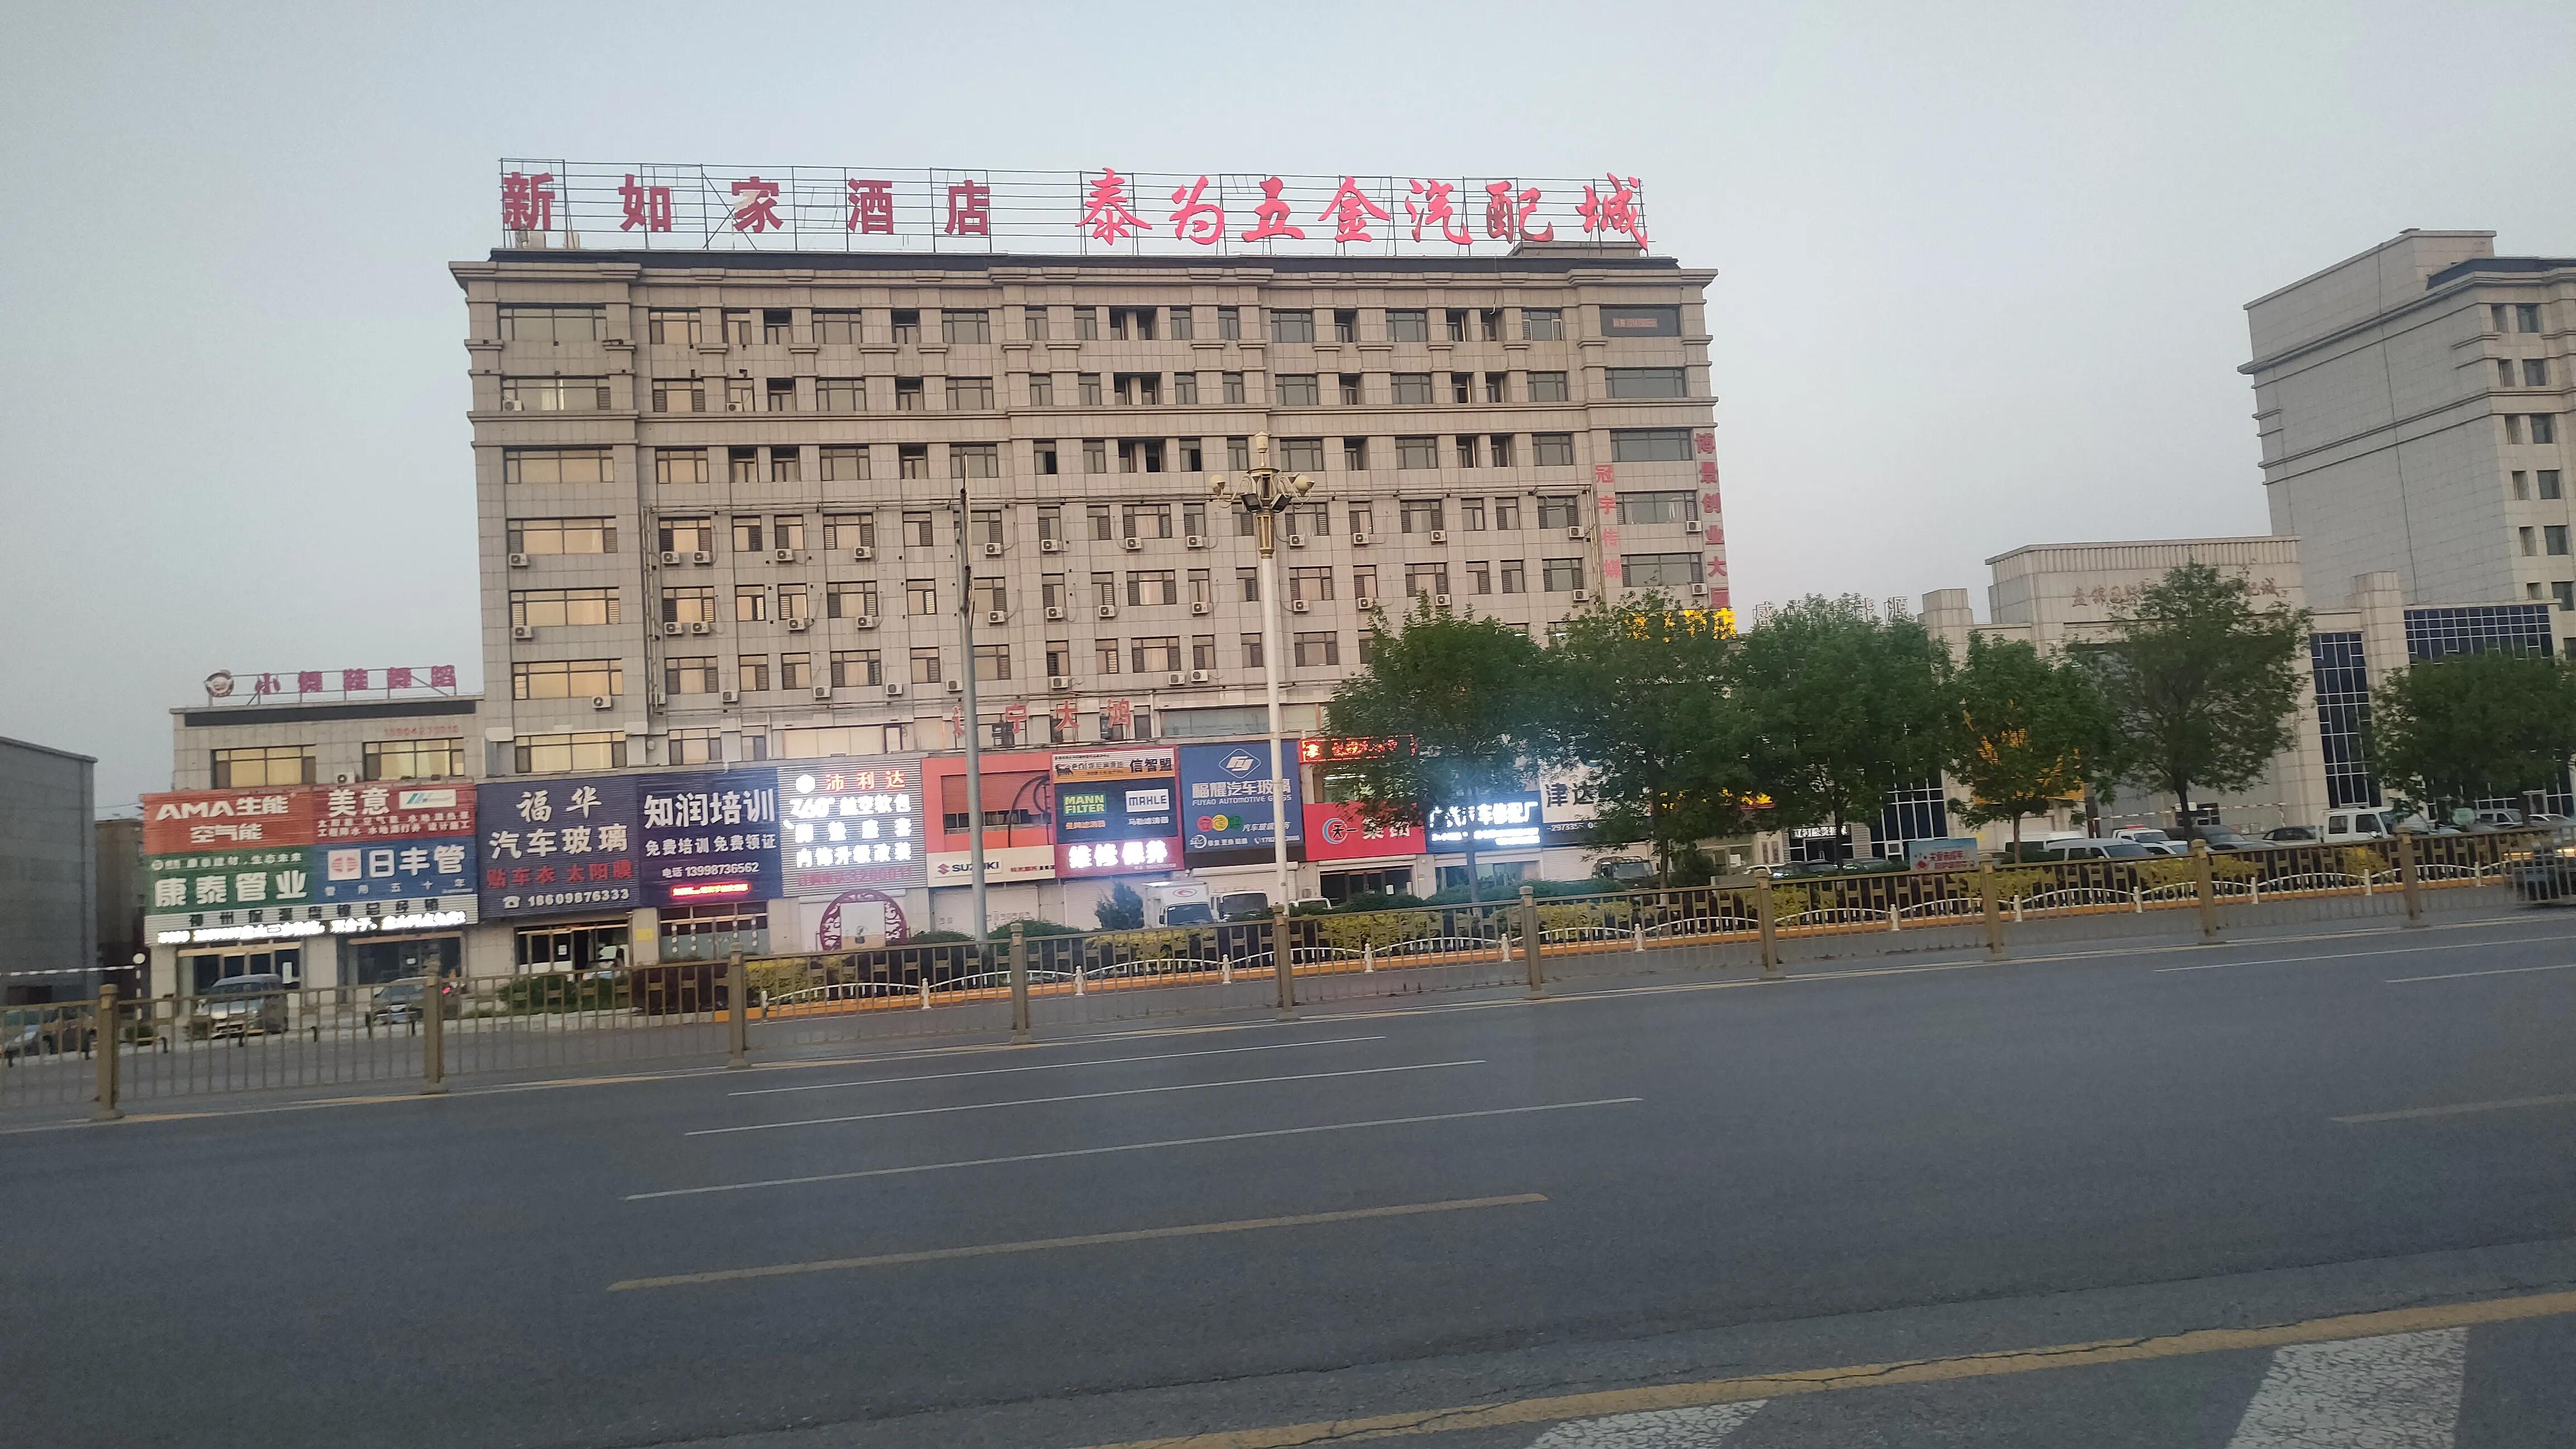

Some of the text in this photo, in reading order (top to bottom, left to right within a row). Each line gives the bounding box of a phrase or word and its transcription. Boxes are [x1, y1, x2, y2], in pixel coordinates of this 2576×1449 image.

[503, 172, 990, 235] 新如家酒店
[1077, 166, 1649, 250] 泰为五金汽配城
[825, 770, 906, 791] 沛利达
[328, 788, 390, 817] 美意
[516, 785, 602, 823] 福华
[643, 788, 776, 830] 知润培训
[1064, 794, 1104, 806] MANN
[1064, 803, 1105, 815] FILTER
[1129, 794, 1167, 806] MAHLE
[1219, 796, 1266, 806] AUTOMOTIVE
[191, 823, 263, 844] 空气能
[489, 823, 628, 859] 汽车玻璃
[645, 832, 777, 857] 免费培训 免费领证
[368, 844, 466, 878] 日丰管
[565, 859, 633, 883] 太阳膜
[952, 861, 999, 872] SUKI
[155, 870, 308, 907] 康泰管业
